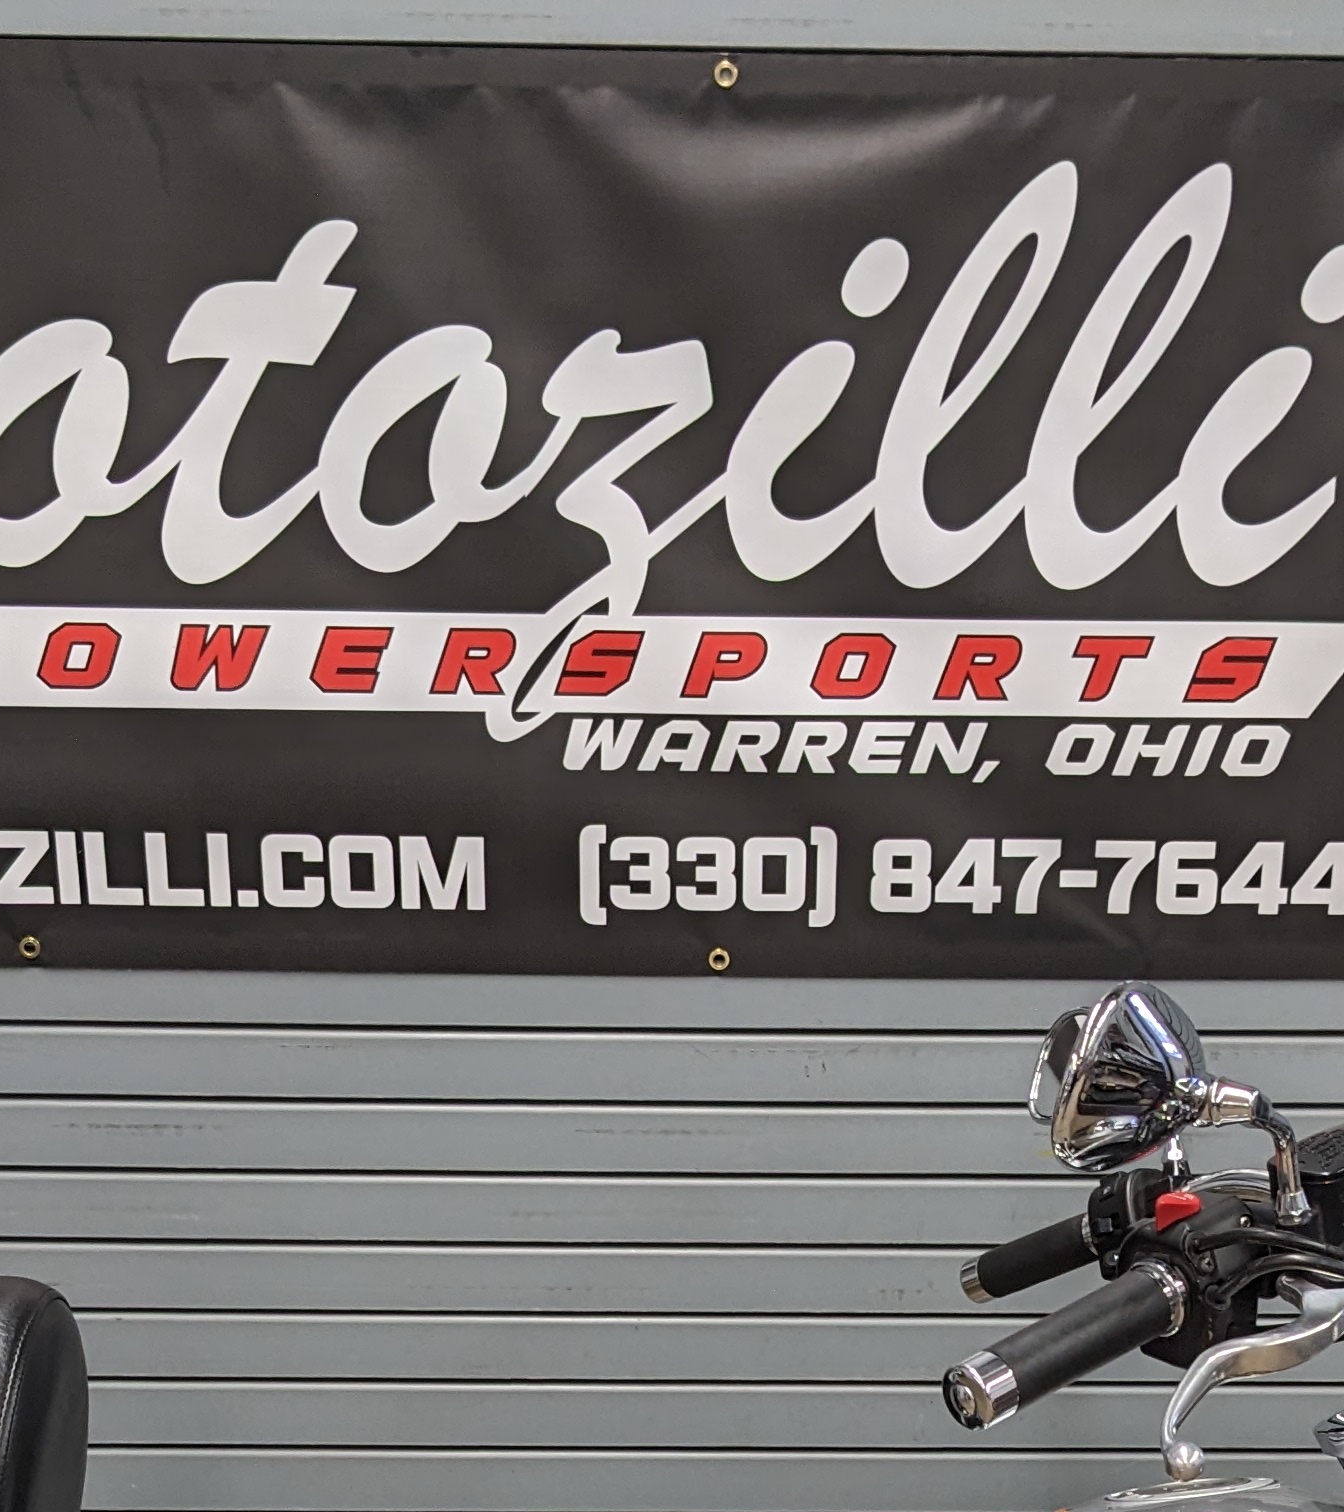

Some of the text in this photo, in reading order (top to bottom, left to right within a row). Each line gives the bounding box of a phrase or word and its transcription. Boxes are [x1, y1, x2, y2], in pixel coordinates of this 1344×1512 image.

[561, 717, 1291, 784] WARREN, OHIO
[578, 824, 838, 928] (330)
